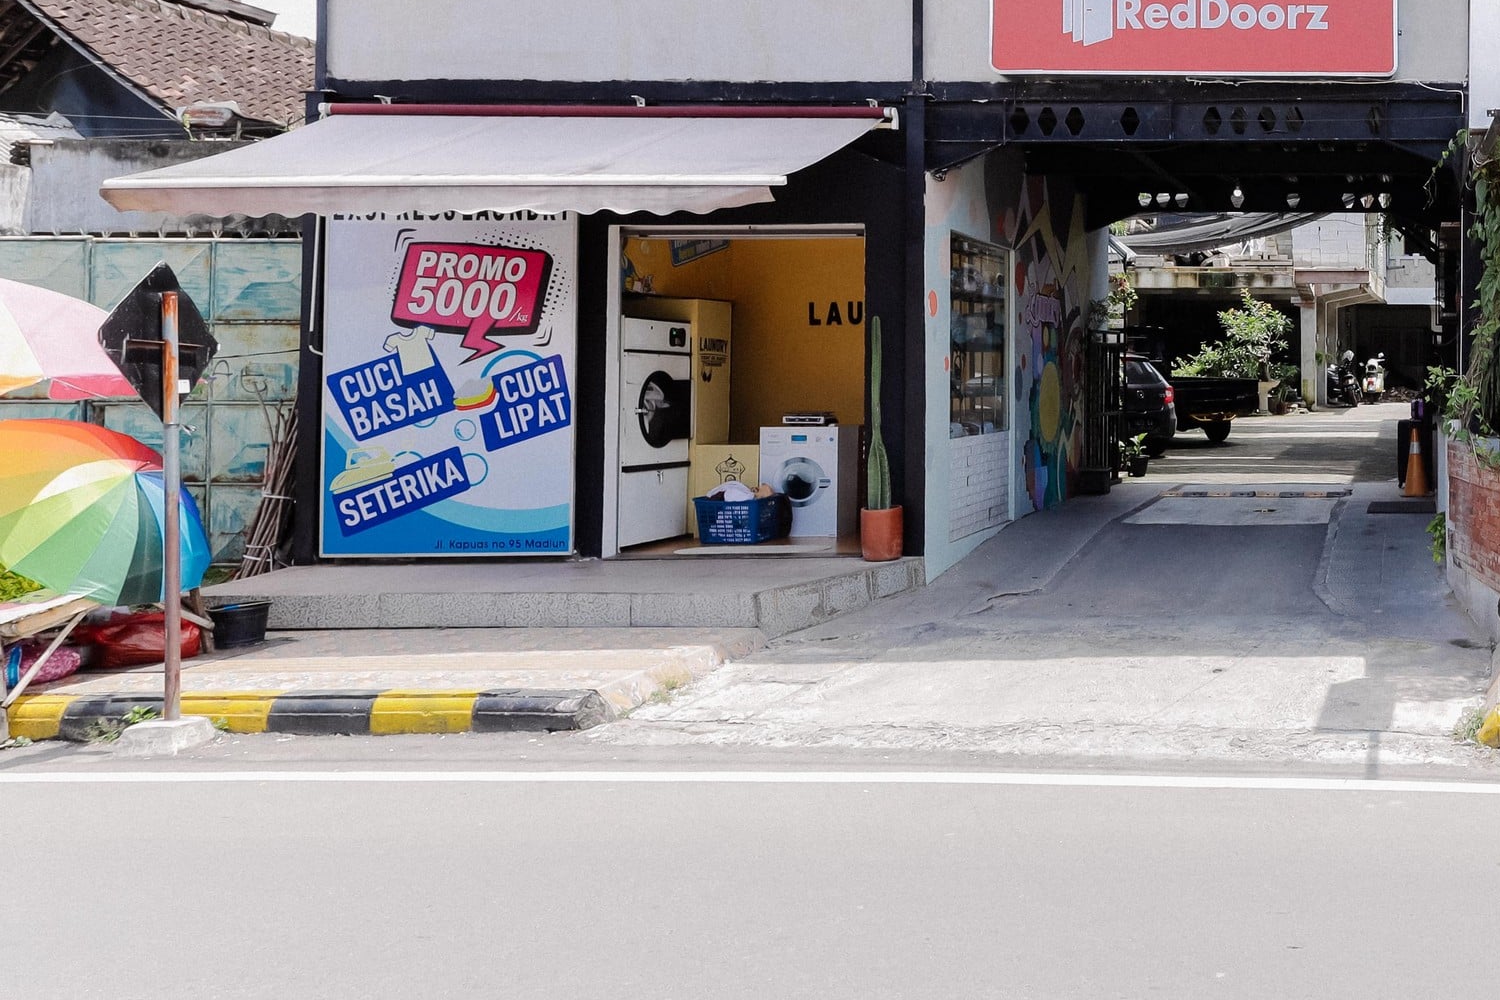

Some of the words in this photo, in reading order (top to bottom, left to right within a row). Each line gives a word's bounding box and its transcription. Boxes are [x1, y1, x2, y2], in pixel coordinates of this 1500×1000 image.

[416, 251, 527, 282] PROMO
[407, 277, 517, 320] 5000
[339, 358, 403, 404] CUCI
[500, 362, 561, 404] CUCI
[349, 378, 443, 437] BASAH
[493, 391, 568, 440] LIPAT
[338, 457, 465, 529] SETERIKA
[449, 539, 489, 550] Kapuas
[491, 541, 506, 549] no
[508, 539, 522, 549] 95
